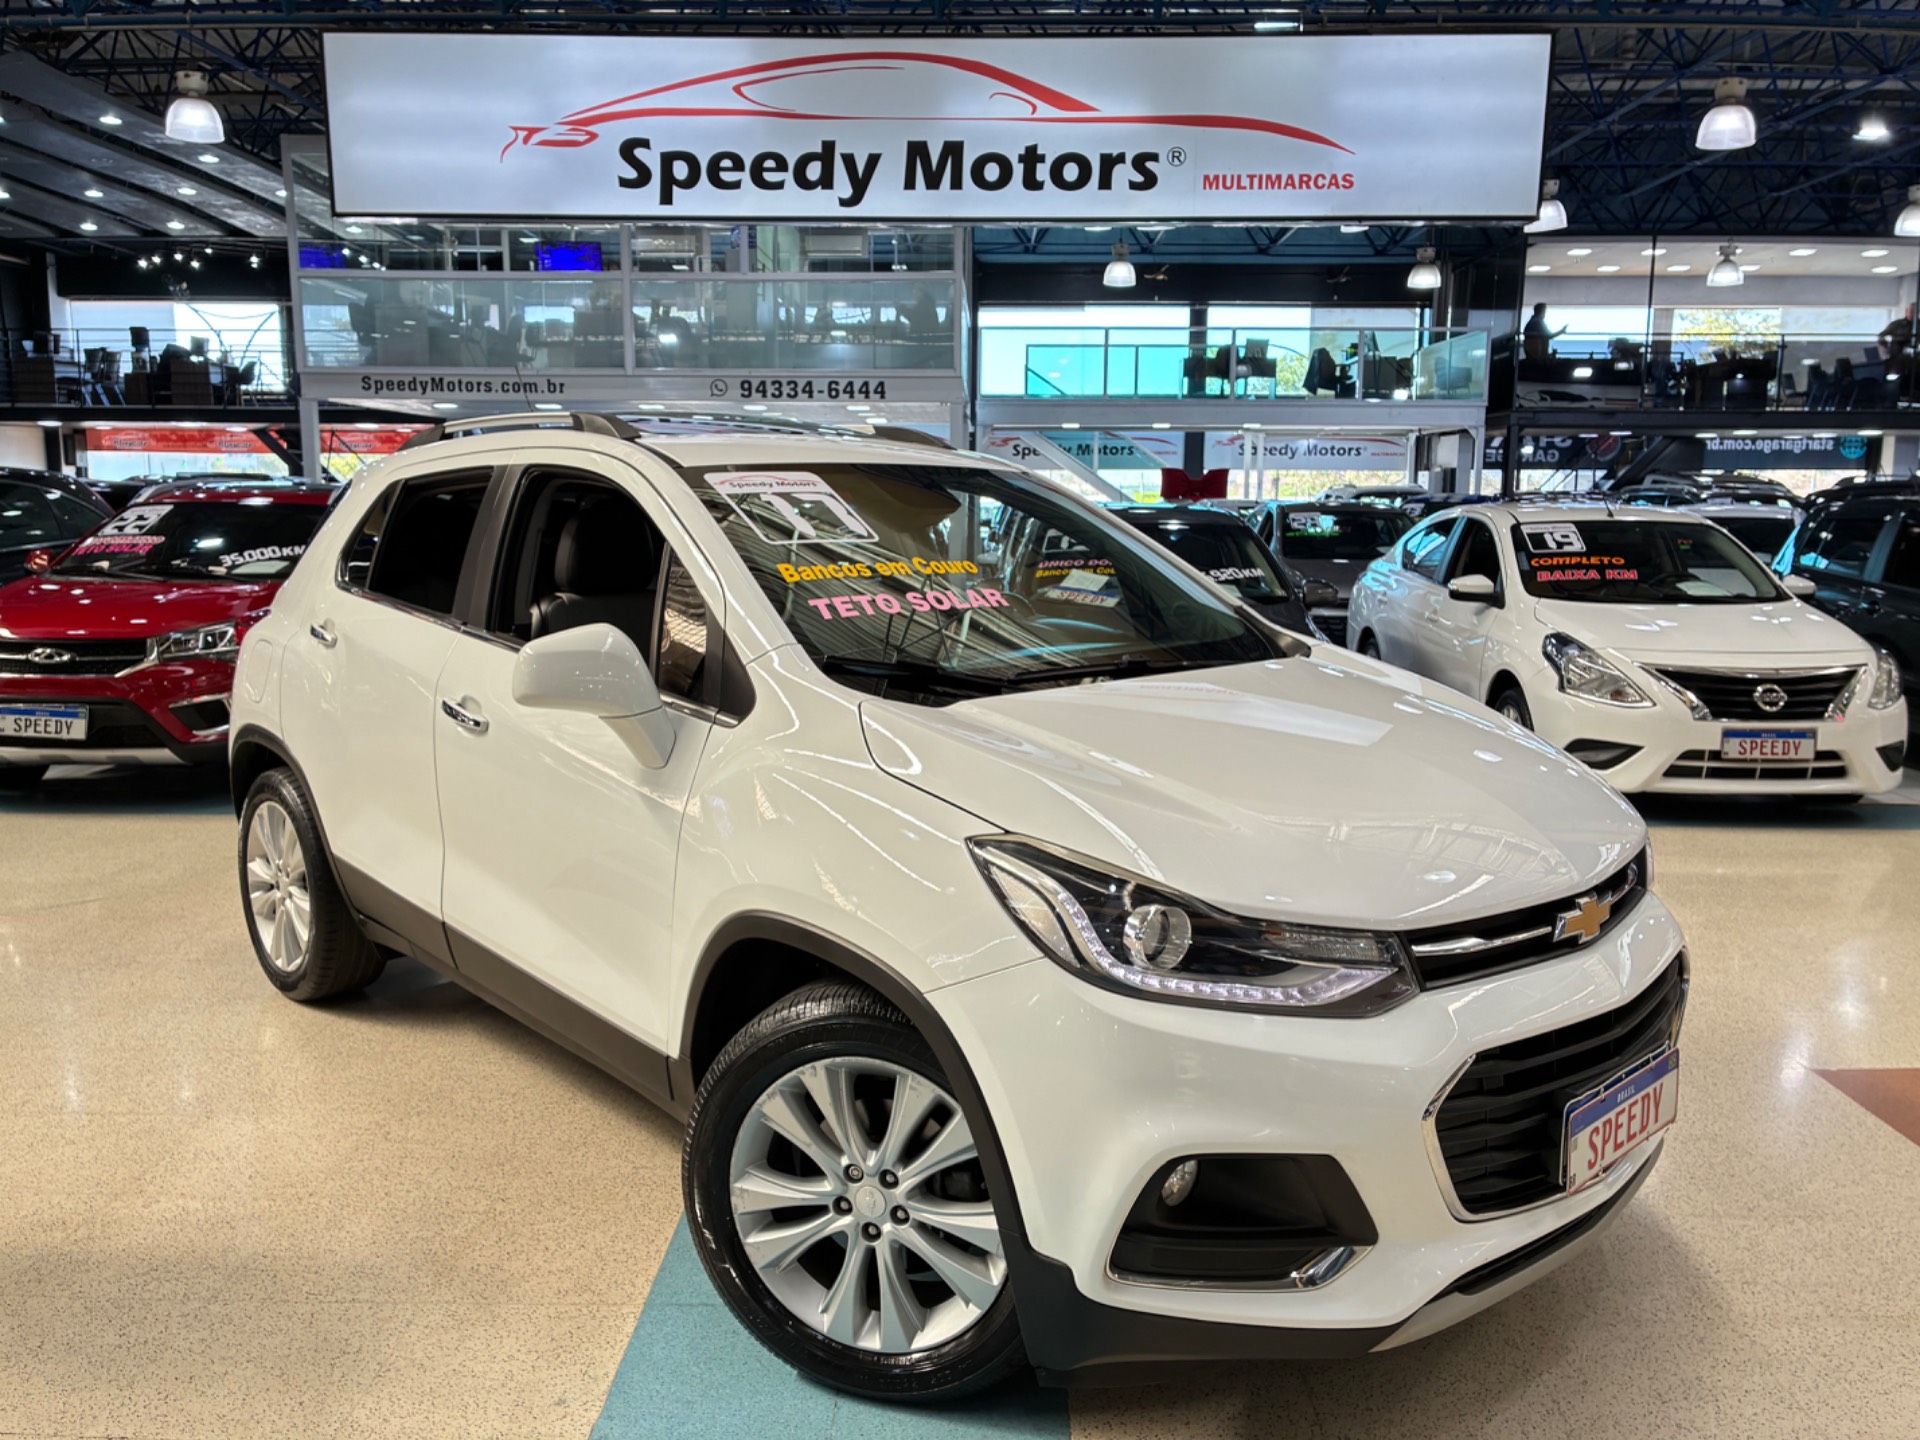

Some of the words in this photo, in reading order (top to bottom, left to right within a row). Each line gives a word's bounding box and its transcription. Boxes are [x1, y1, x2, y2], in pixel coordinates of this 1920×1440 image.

[617, 137, 883, 208] Speedy
[1202, 173, 1356, 190] MULTIMARCAS
[361, 375, 566, 395] SpeedyMotors.com.br
[740, 379, 887, 400] 94334-6444
[1543, 531, 1582, 550] 19
[776, 561, 872, 583] Bancos
[875, 560, 913, 576] em
[911, 556, 979, 575] Couro
[1530, 556, 1626, 567] COMPLETO
[1537, 569, 1601, 582] BAIXA
[1605, 569, 1638, 580] KM
[807, 593, 901, 621] TETO
[905, 588, 1010, 613] SOLAR
[13, 717, 73, 735] SPEEDY
[1738, 739, 1801, 756] SPEEDY
[1587, 1082, 1663, 1171] SPEEDY
